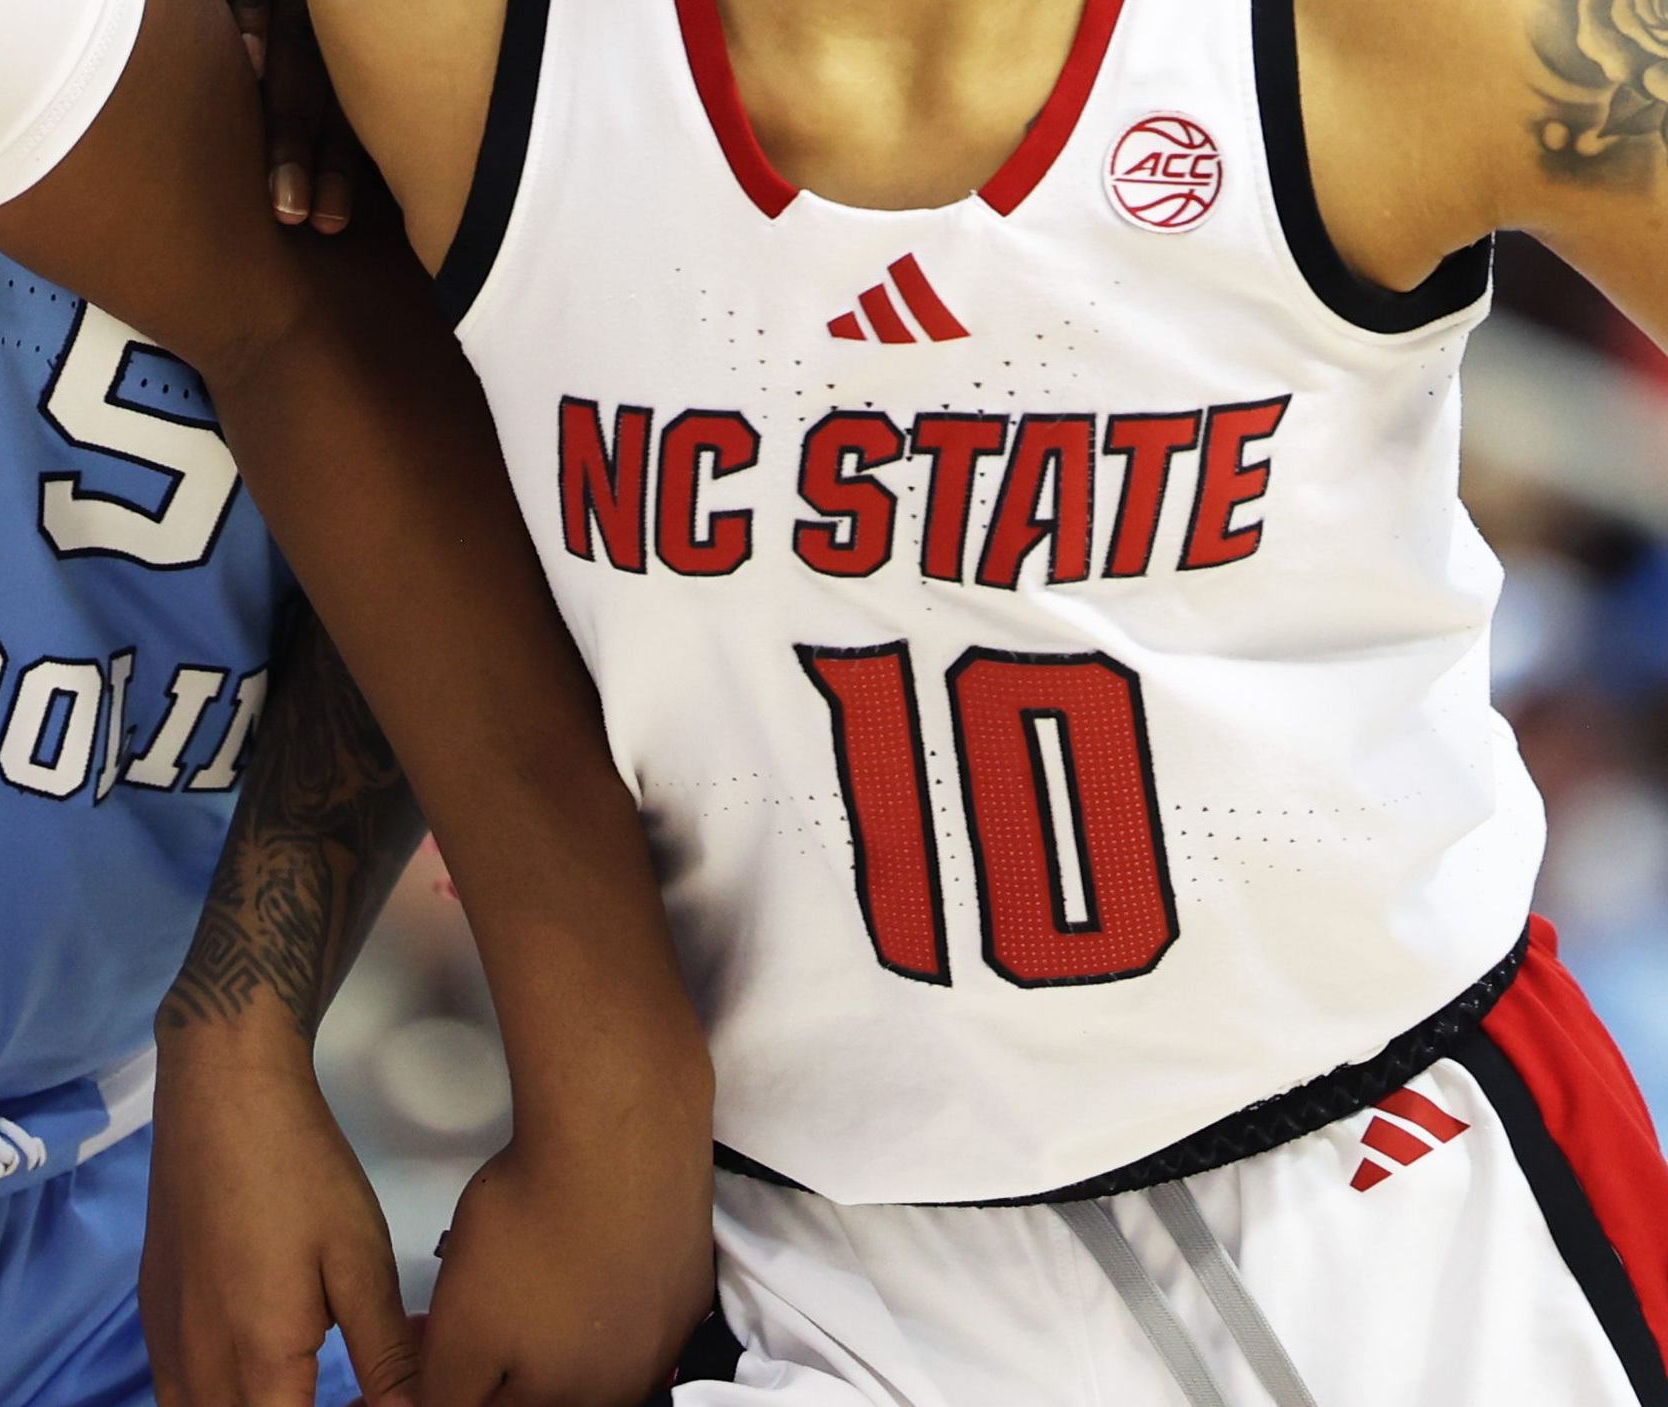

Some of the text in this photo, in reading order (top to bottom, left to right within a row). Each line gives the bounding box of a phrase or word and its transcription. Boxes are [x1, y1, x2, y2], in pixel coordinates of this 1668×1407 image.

[1123, 152, 1220, 179] ACC
[37, 297, 243, 571] 5
[558, 392, 1293, 592] NC STATE
[792, 638, 1181, 990] 10
